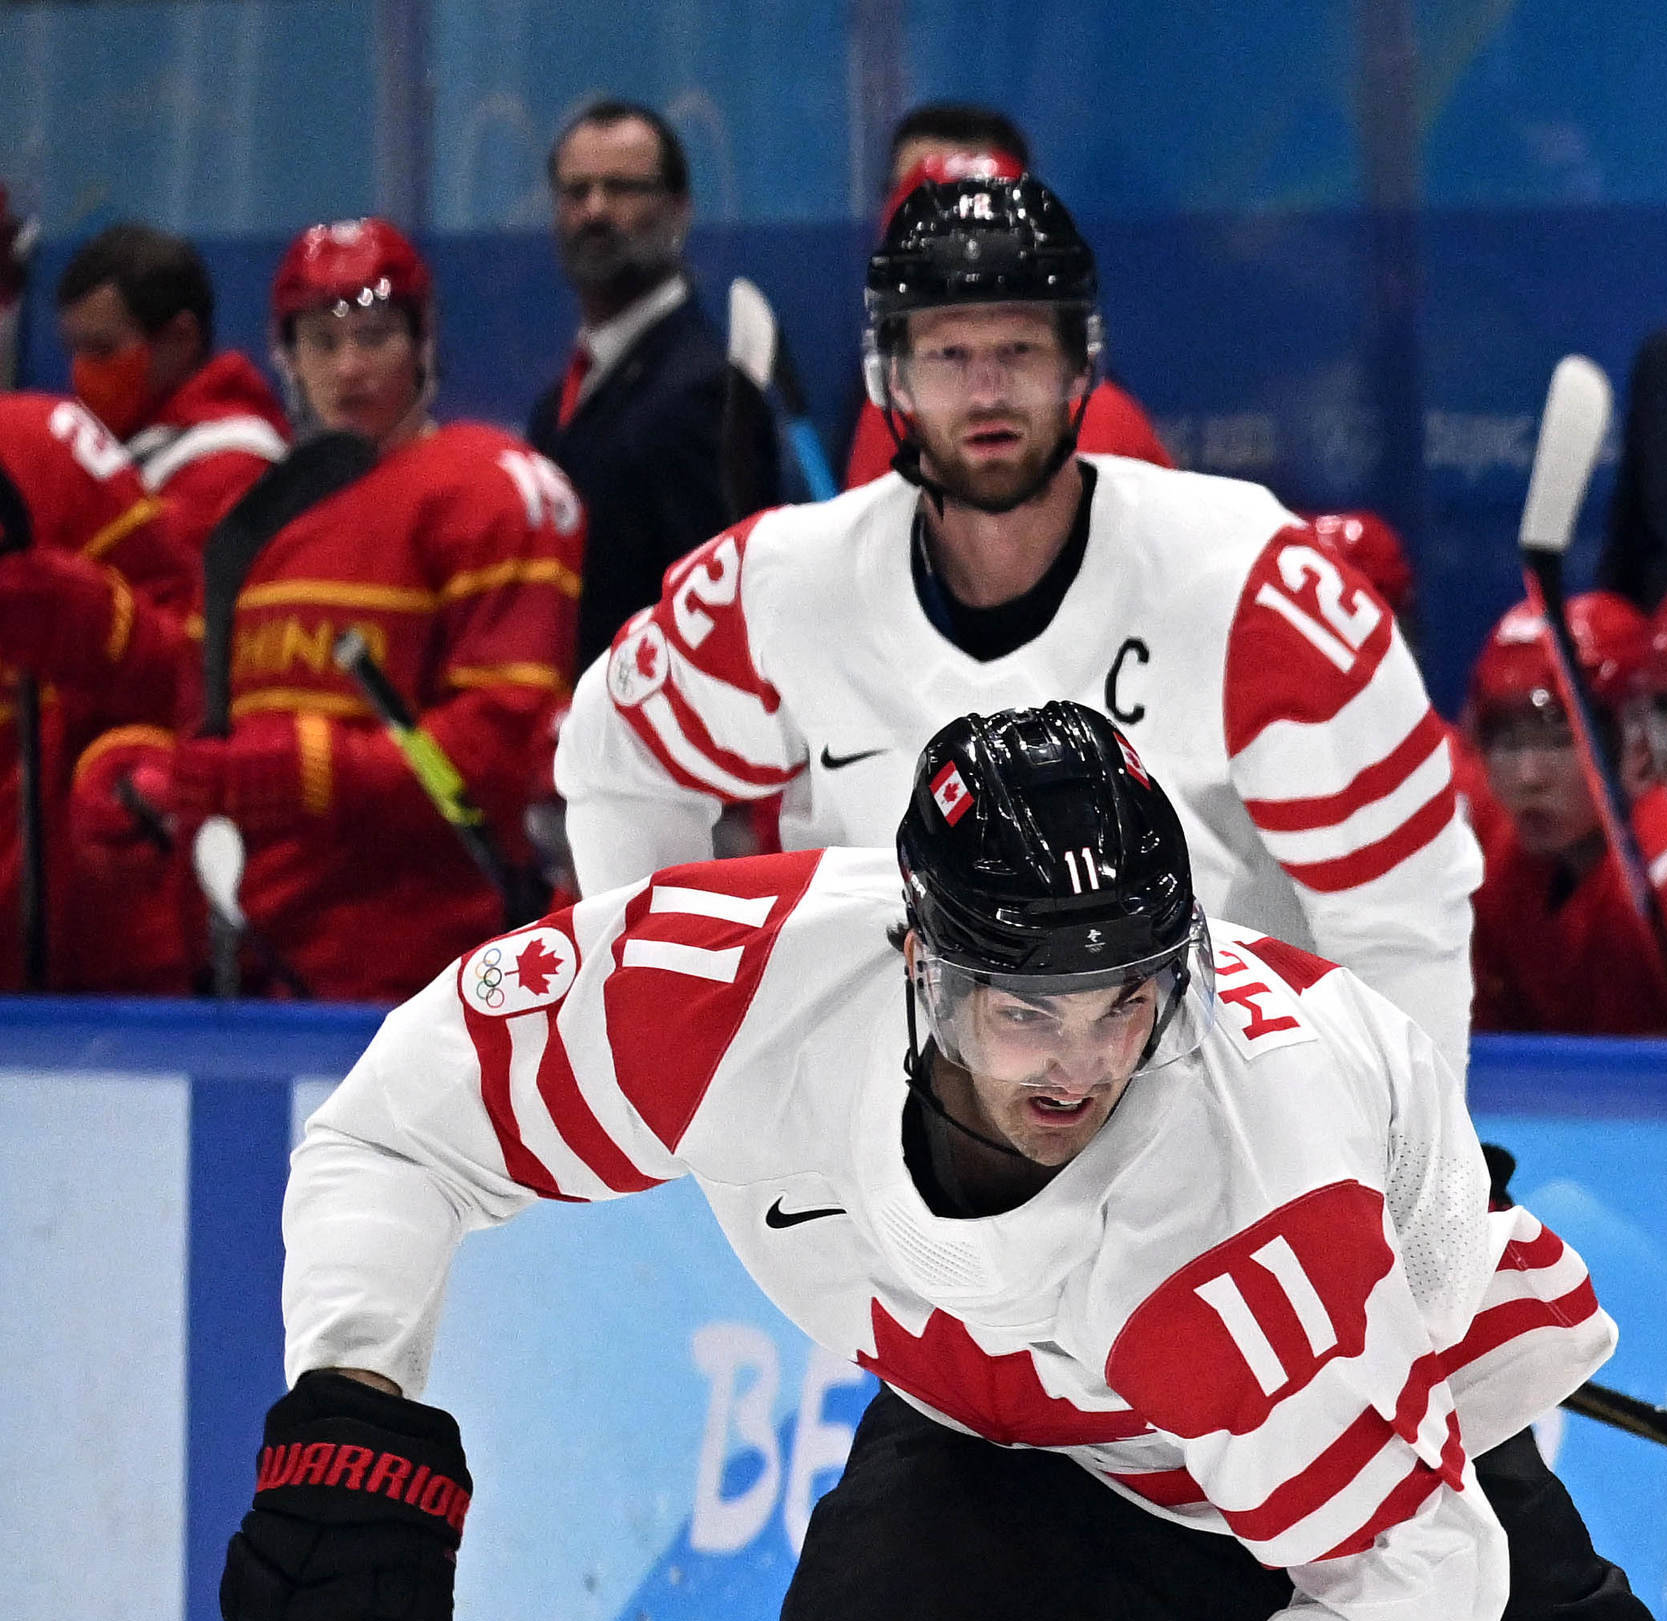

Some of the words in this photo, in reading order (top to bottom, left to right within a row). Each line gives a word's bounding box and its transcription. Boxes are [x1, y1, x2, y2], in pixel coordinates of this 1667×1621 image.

[1255, 544, 1381, 674] 12
[1105, 636, 1151, 725] C
[1063, 846, 1100, 895] 11
[622, 885, 779, 984] 11
[1193, 1234, 1338, 1397] 11
